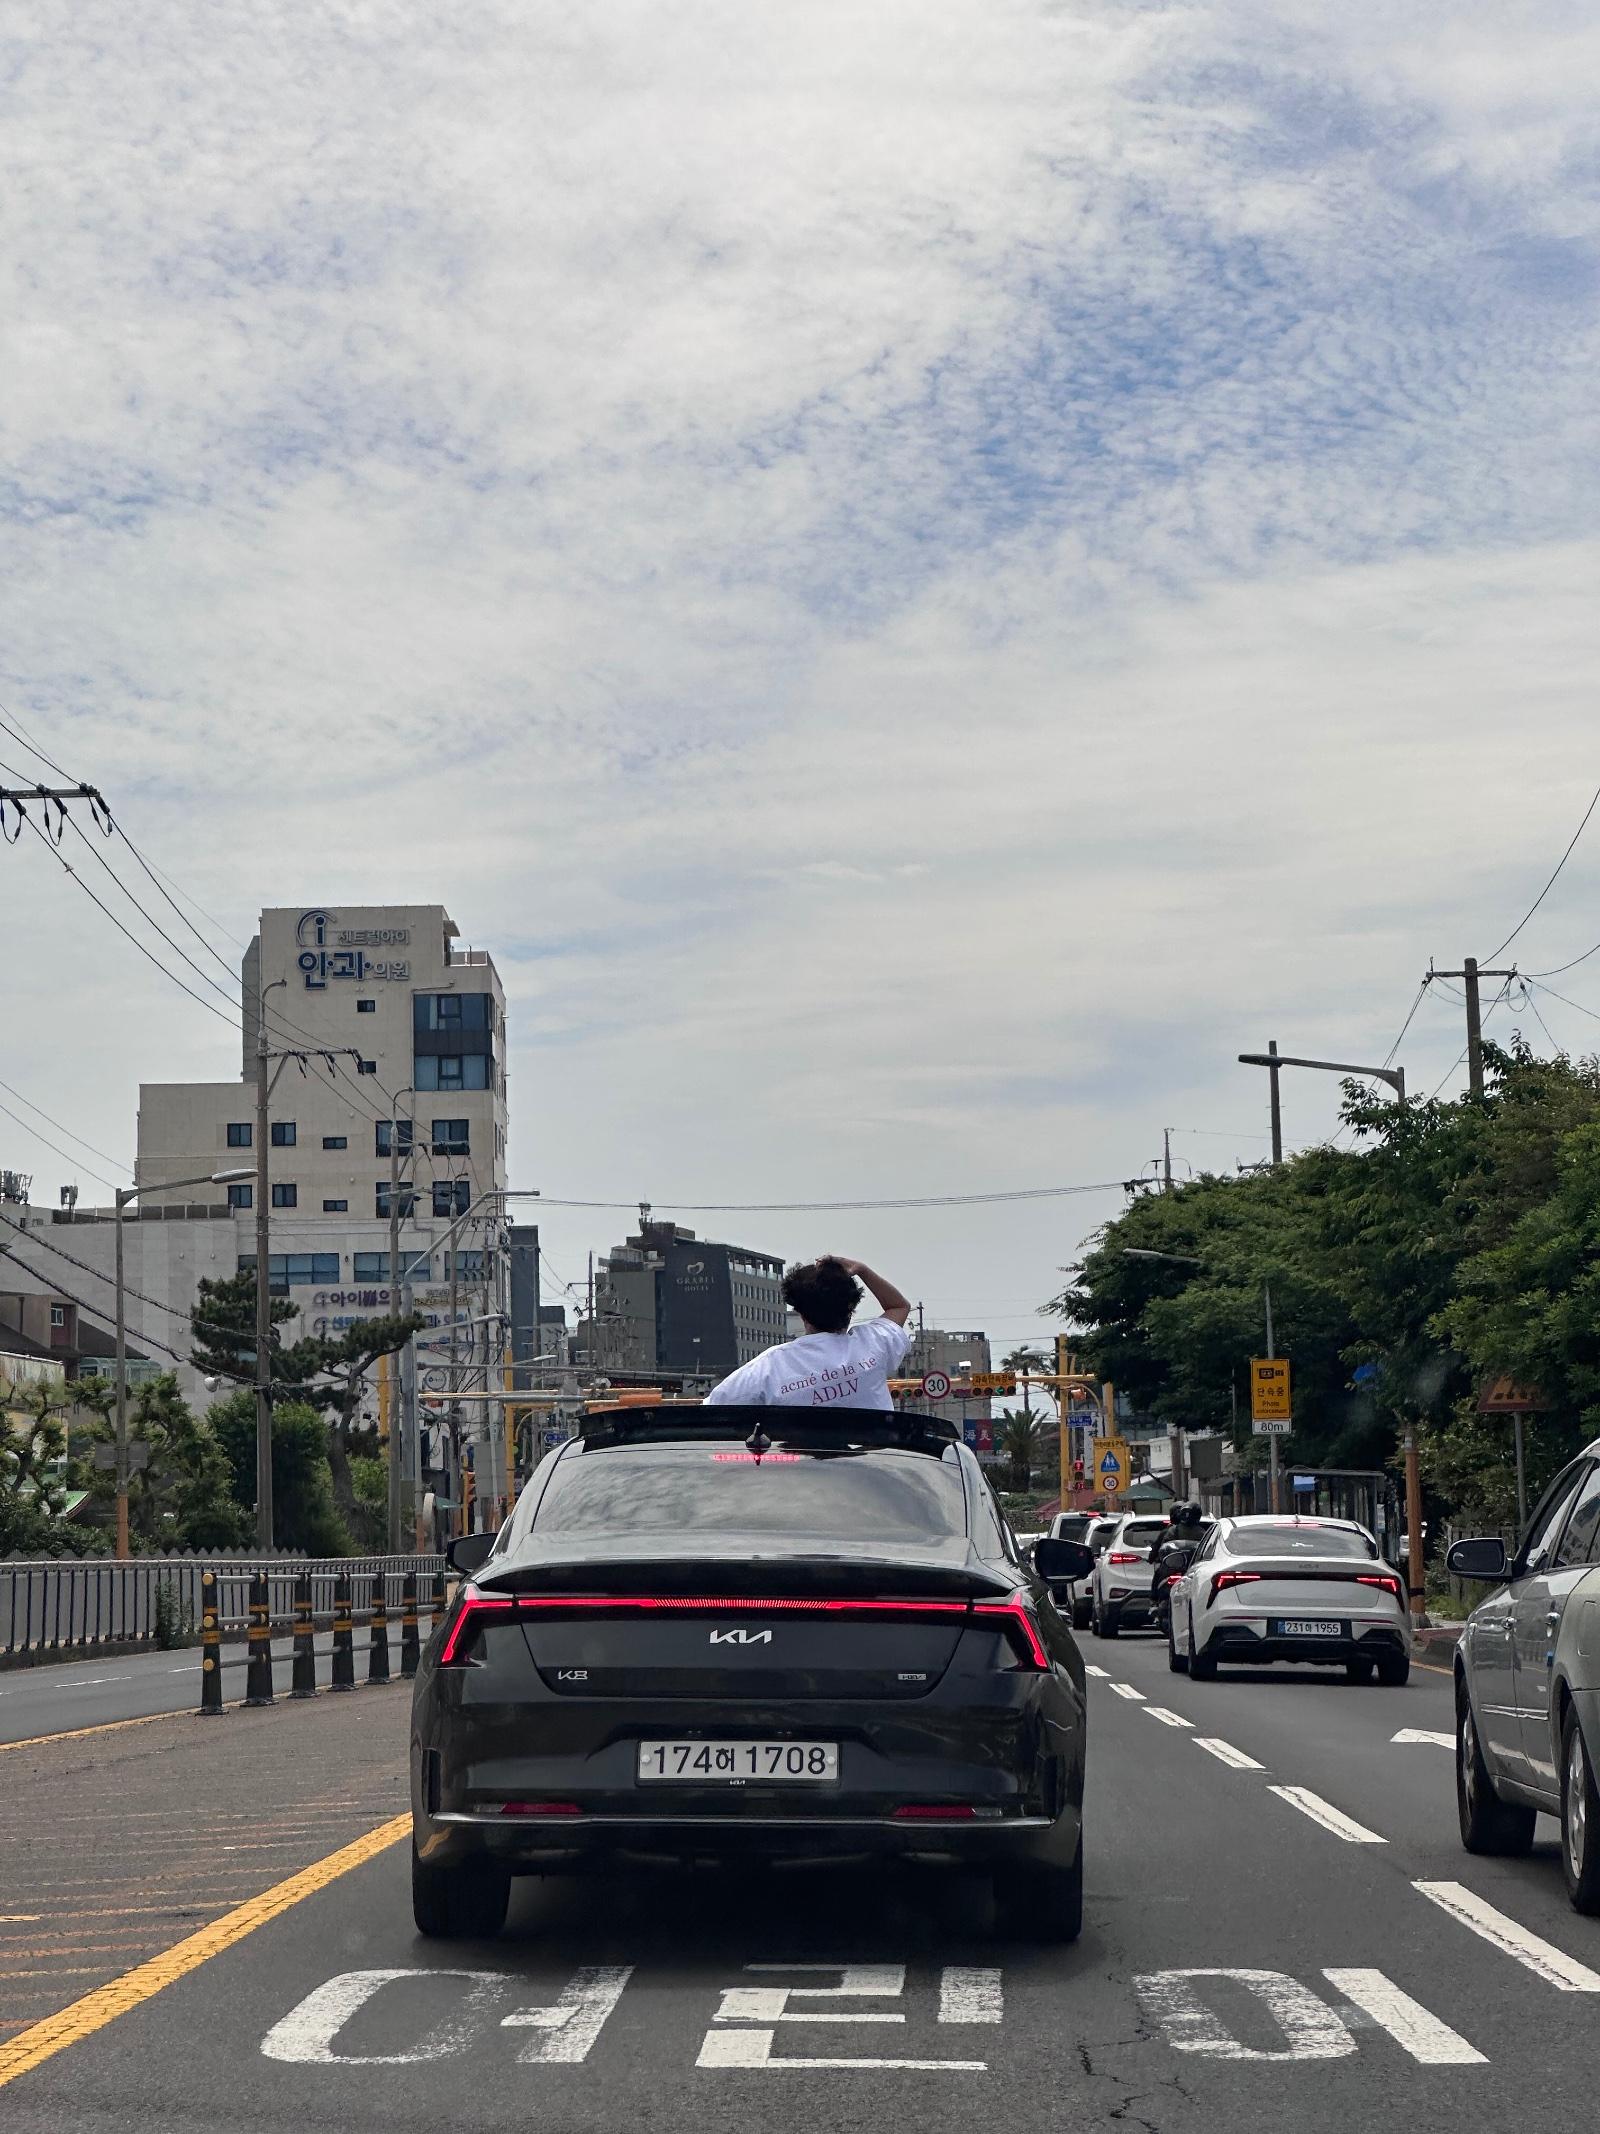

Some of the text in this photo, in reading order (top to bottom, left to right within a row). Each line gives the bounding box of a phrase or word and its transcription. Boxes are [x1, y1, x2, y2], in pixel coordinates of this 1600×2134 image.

[339, 929, 409, 945] 센트럴아이
[781, 1372, 817, 1394] acmé
[821, 1369, 838, 1382] de
[841, 1364, 857, 1377] la
[927, 1379, 945, 1392] 30
[811, 1378, 859, 1405] ADLV
[1261, 1422, 1284, 1431] 80m
[1106, 1479, 1115, 1487] 30
[1315, 1623, 1339, 1634] 1955
[709, 1629, 773, 1644] KIA
[558, 1670, 588, 1680] K8
[653, 1746, 826, 1774] 174허 1708
[260, 1964, 1492, 2069] 어린이
